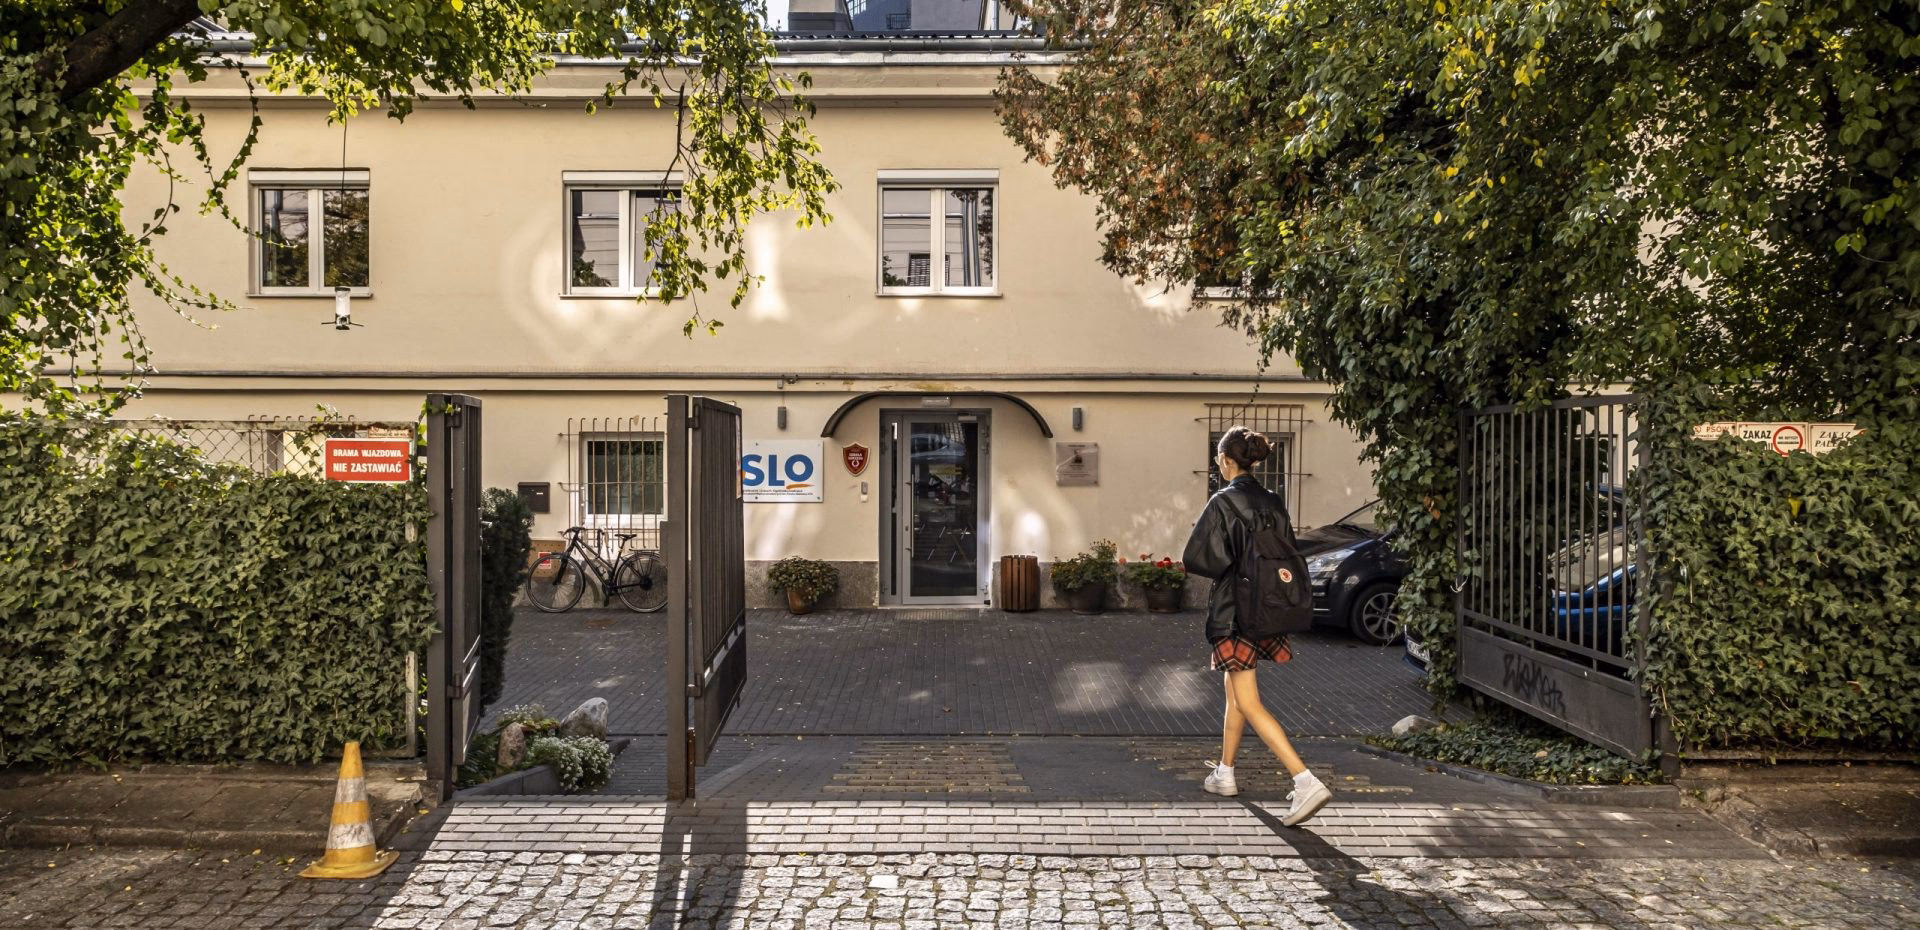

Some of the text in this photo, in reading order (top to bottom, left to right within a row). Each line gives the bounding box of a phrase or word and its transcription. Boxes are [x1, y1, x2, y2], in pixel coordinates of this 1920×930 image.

[1743, 430, 1772, 439] ZAKAZ
[333, 449, 403, 457] BRAMA WJAZDOWA.
[333, 461, 402, 473] NIE ZASTAWIAĆ
[742, 453, 814, 487] SLO
